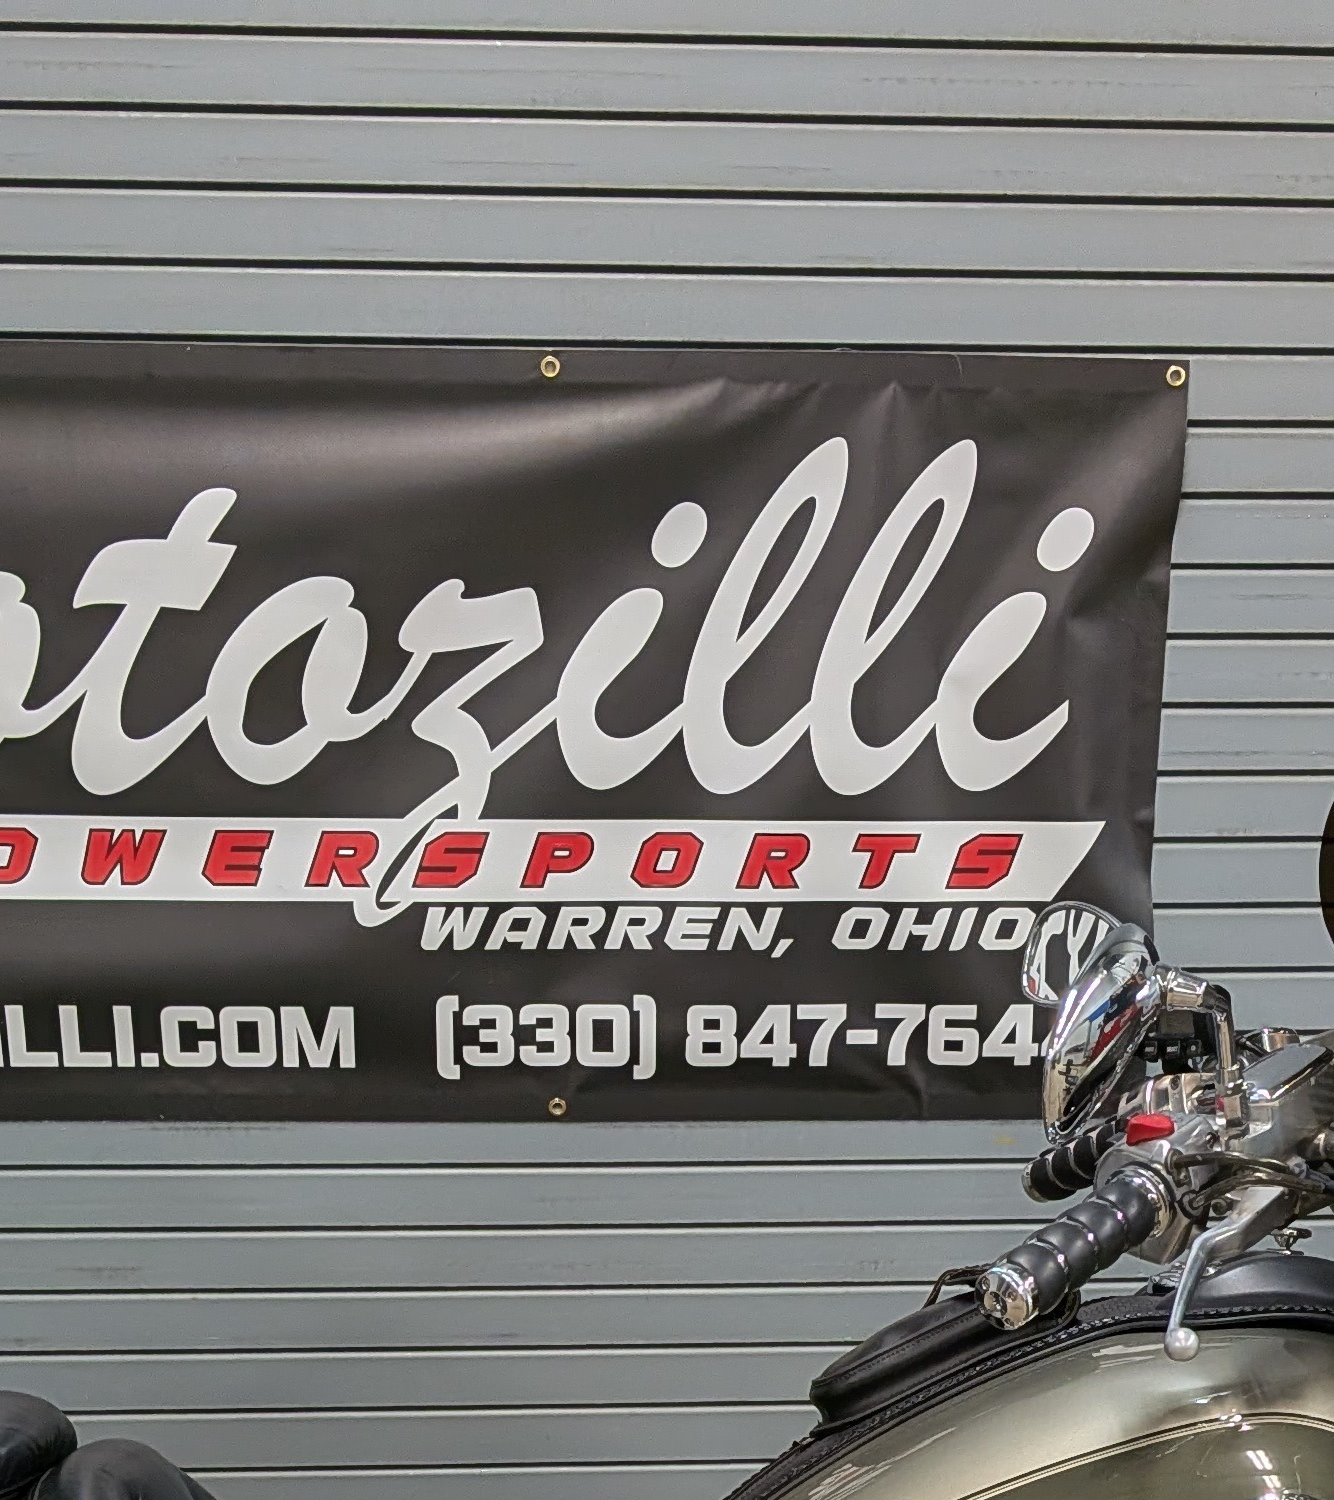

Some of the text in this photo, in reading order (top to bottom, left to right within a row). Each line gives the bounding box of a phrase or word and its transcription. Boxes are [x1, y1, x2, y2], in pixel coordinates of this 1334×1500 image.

[420, 905, 1037, 958] WARREN, OHIO
[685, 1003, 1053, 1067] 847-764
